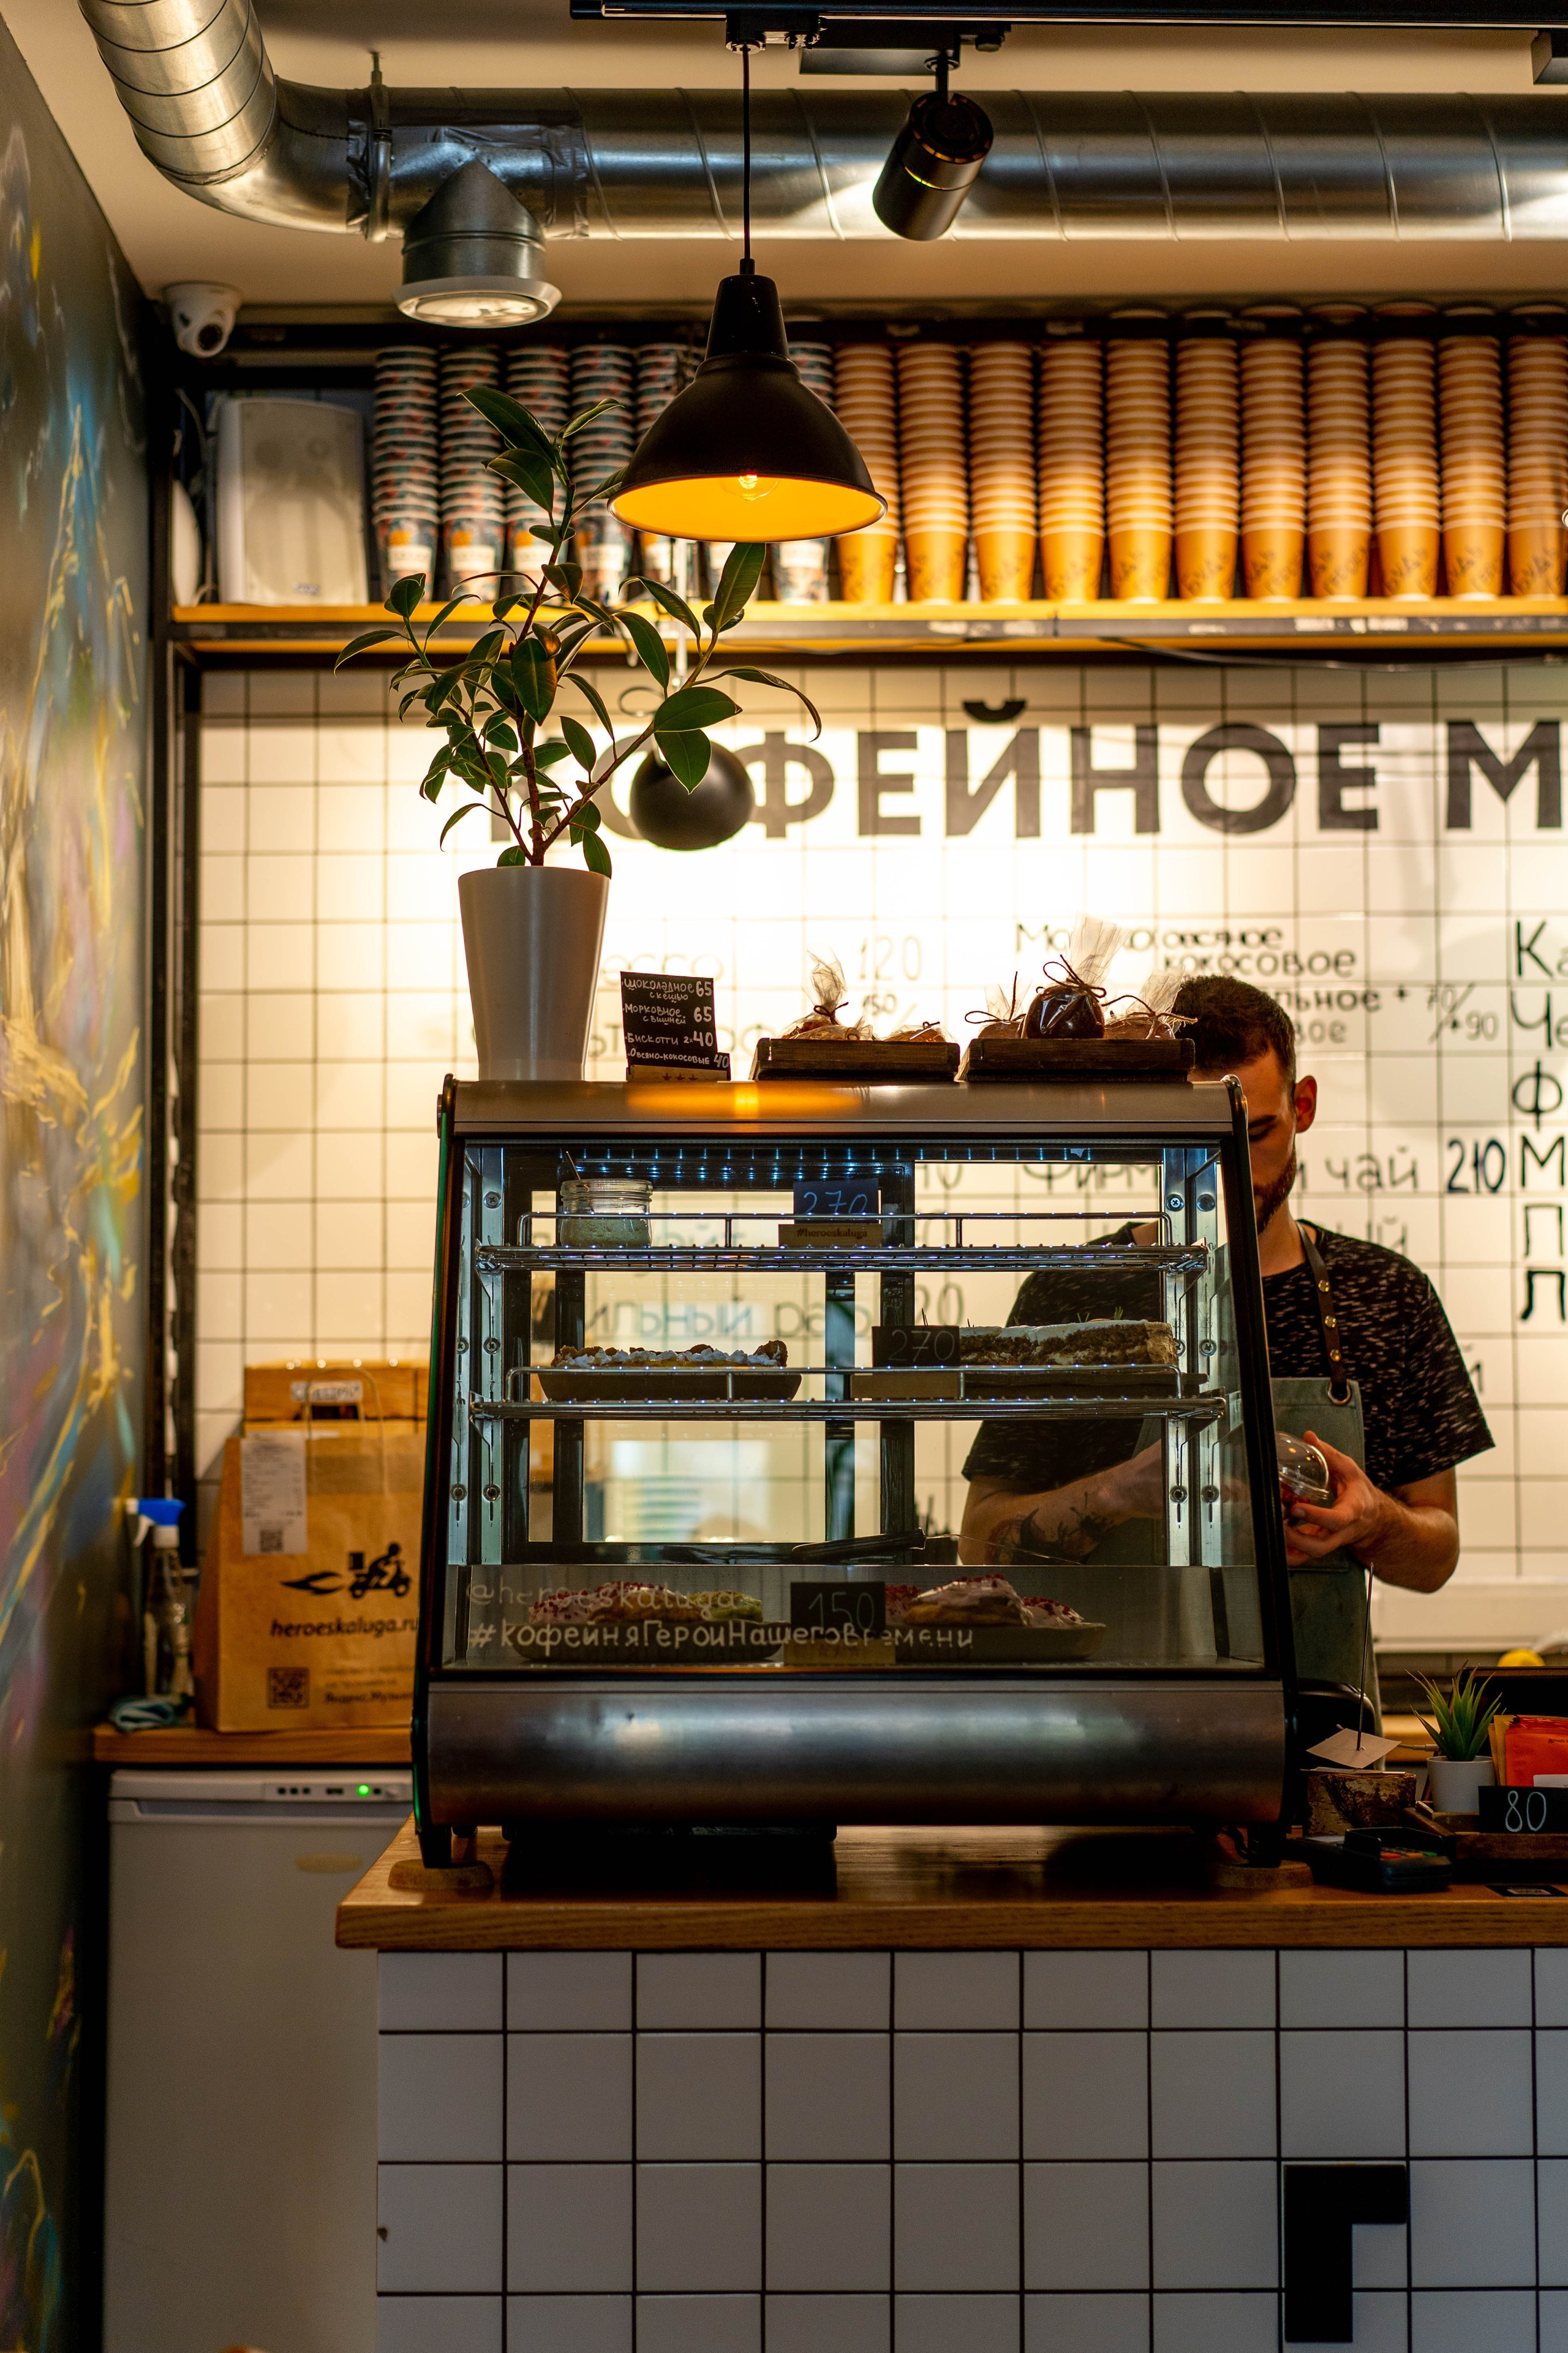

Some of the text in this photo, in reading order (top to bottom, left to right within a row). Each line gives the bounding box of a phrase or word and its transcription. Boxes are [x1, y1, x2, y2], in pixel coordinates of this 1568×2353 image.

[860, 935, 923, 981] 120
[624, 978, 712, 997] Шоколадное 65
[656, 993, 688, 1003] кешью
[625, 1003, 712, 1022] Морковное 65
[650, 1015, 686, 1025] вишней
[627, 1032, 679, 1046] Бискотти
[714, 1054, 729, 1068] 40
[1325, 1145, 1419, 1190] чай
[804, 1190, 868, 1214] 270
[797, 1228, 868, 1239] #heroeskaluga
[889, 1329, 955, 1362] 270
[466, 1576, 736, 1620] @heroeskaluga
[809, 1592, 875, 1631] 150
[1505, 1790, 1547, 1832] 80
